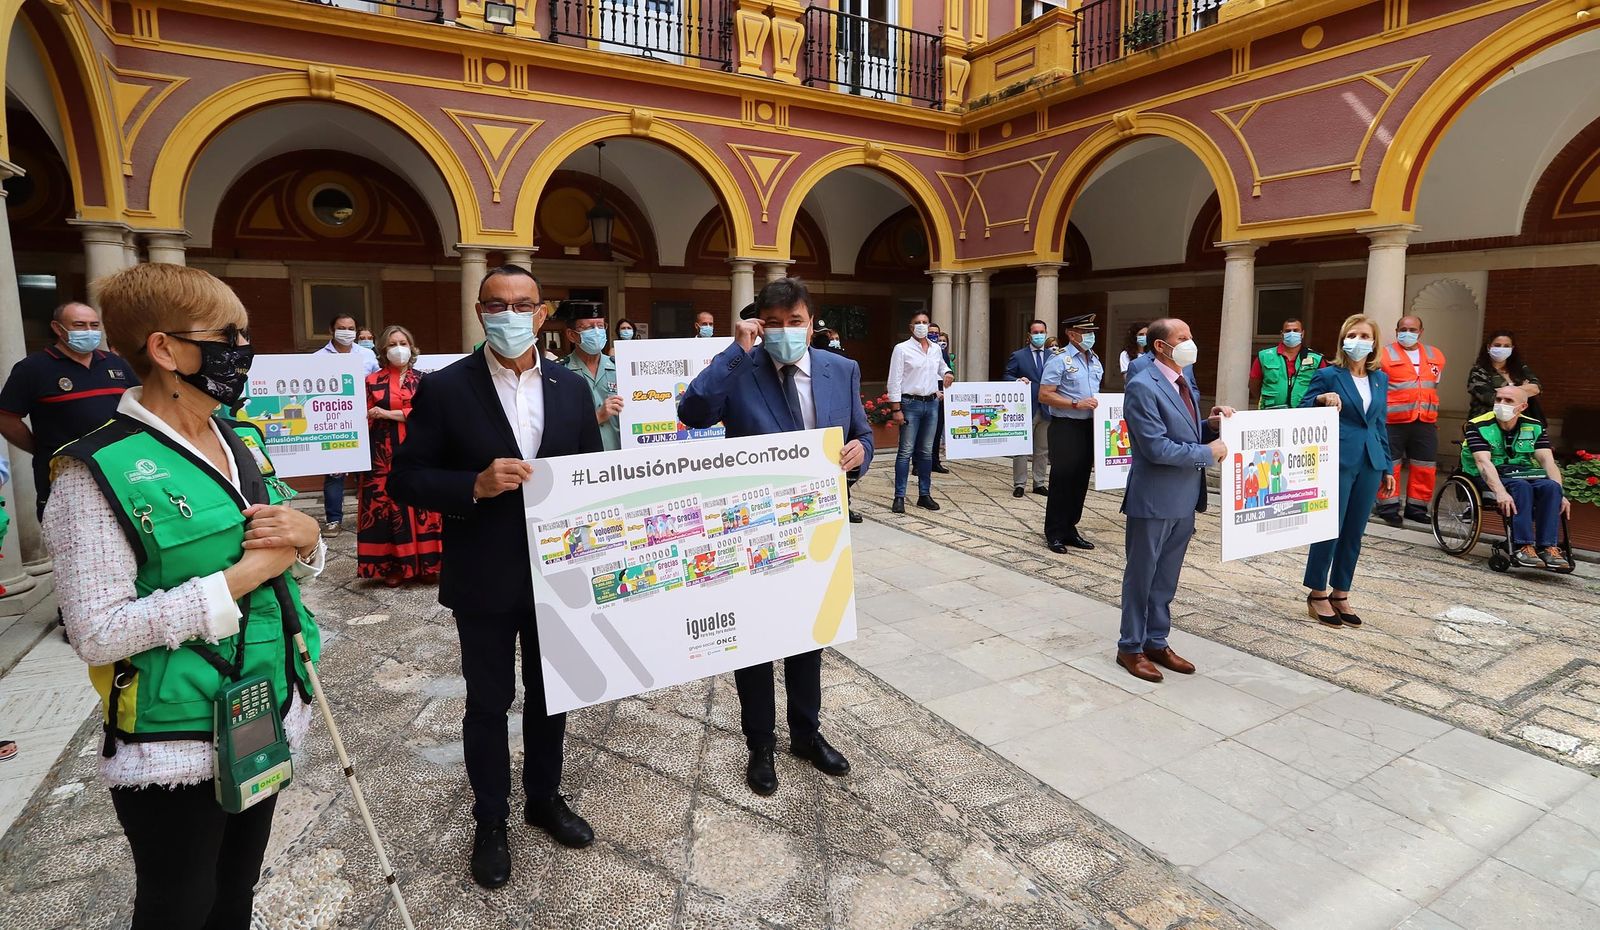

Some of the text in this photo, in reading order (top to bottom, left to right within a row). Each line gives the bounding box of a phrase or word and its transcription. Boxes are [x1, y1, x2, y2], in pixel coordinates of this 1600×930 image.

[276, 377, 339, 394] 00000
[632, 390, 672, 402] La Paga
[995, 393, 1025, 403] 00000
[312, 398, 353, 412] Gracias
[326, 411, 341, 422] por
[1003, 412, 1025, 422] Gracias
[314, 421, 338, 431] estar
[644, 422, 674, 432] ONCE
[668, 433, 677, 441] 20
[1292, 425, 1328, 445] 00000
[331, 441, 358, 449] ONCE
[571, 444, 810, 487] #LaIlusiónPuedeConTodo
[1288, 451, 1316, 469] Gracias
[809, 477, 836, 491] 00000
[741, 487, 770, 501] 00000
[818, 493, 837, 504] Gracias
[668, 497, 698, 511] 00000
[750, 500, 771, 512] Gracias
[1309, 499, 1328, 509] ONCE
[587, 507, 620, 523] 00000
[676, 511, 699, 523] Gracias
[1236, 515, 1243, 523] 21
[1258, 511, 1265, 520] 20
[594, 524, 623, 537] Volvemos
[779, 526, 802, 538] 00000
[717, 536, 742, 548] 00000
[778, 538, 796, 548] Gracias
[639, 548, 670, 563] 00000
[717, 546, 735, 556] Gracias
[657, 559, 679, 570] Gracias
[686, 612, 736, 640] iguales
[716, 636, 737, 645] ONCE
[260, 773, 281, 788] ONCE
